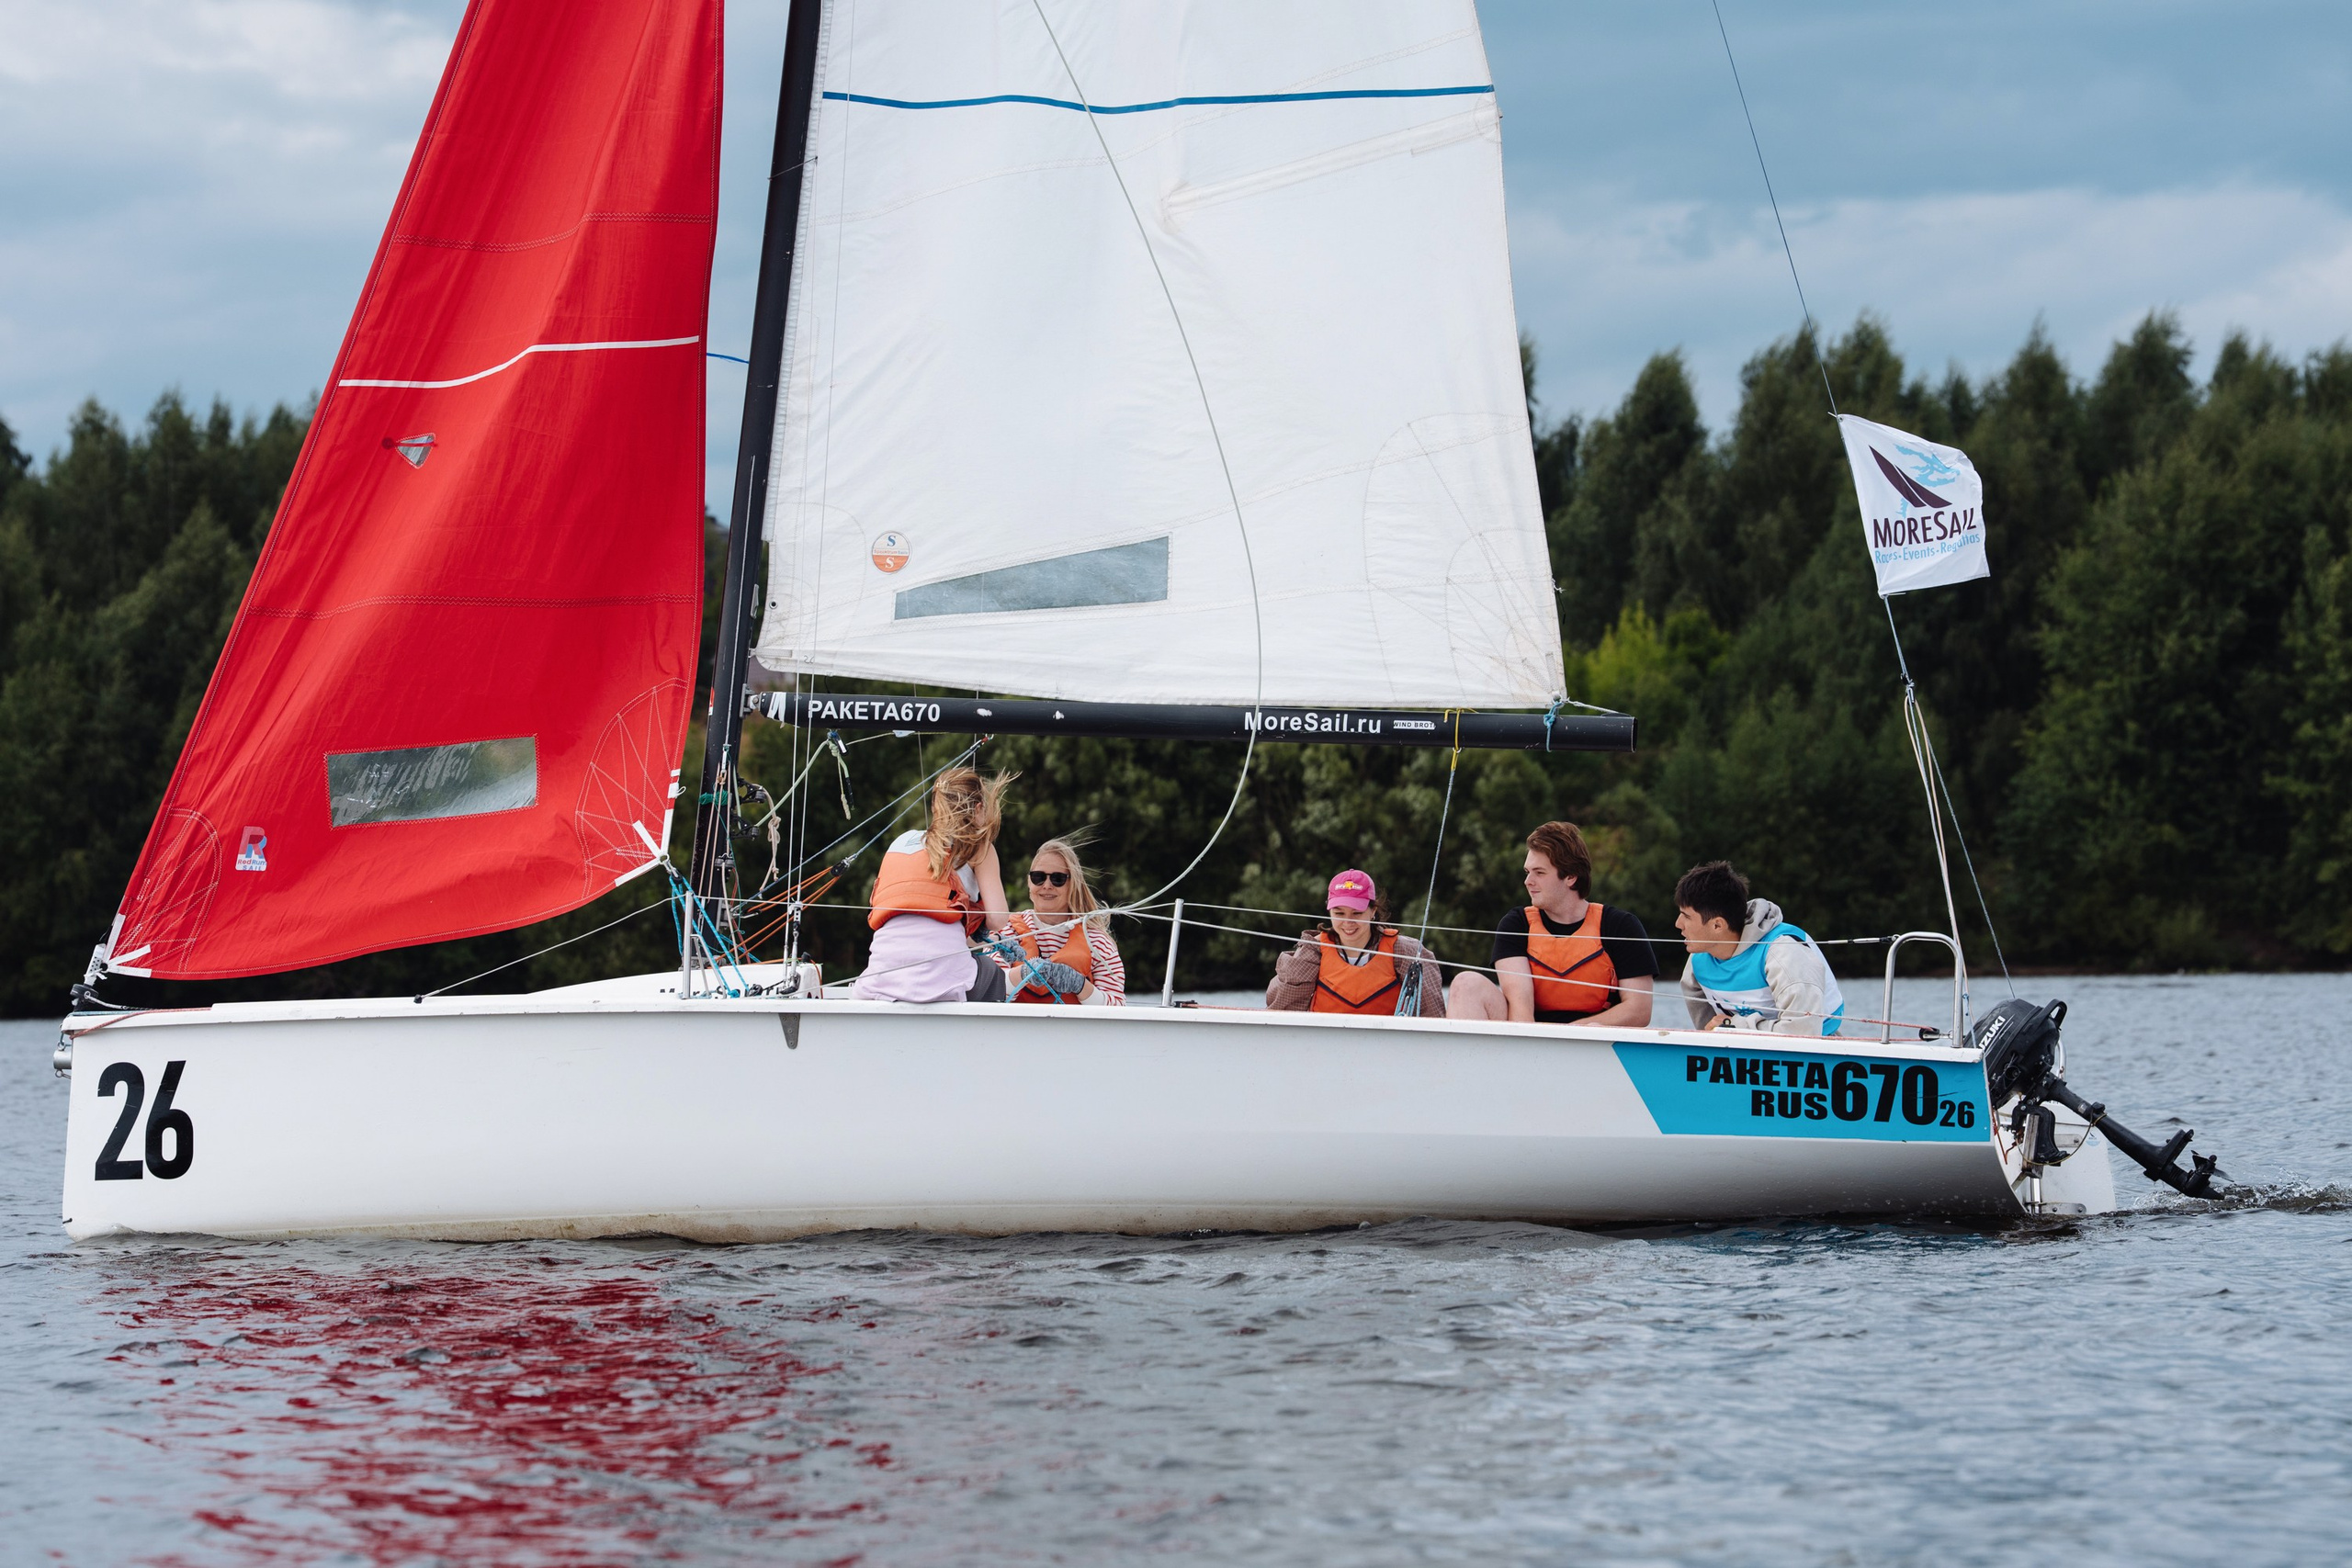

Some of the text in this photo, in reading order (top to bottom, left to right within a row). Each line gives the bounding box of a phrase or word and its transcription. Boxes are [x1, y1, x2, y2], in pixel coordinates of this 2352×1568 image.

[887, 535, 897, 547] S
[885, 557, 895, 569] S
[1244, 711, 1382, 734] MoreSail.ru
[1978, 1015, 2007, 1051] ZUKI
[1750, 1089, 1975, 1129] RUS 26
[1831, 1061, 1939, 1126] 670
[94, 1059, 194, 1181] 26
